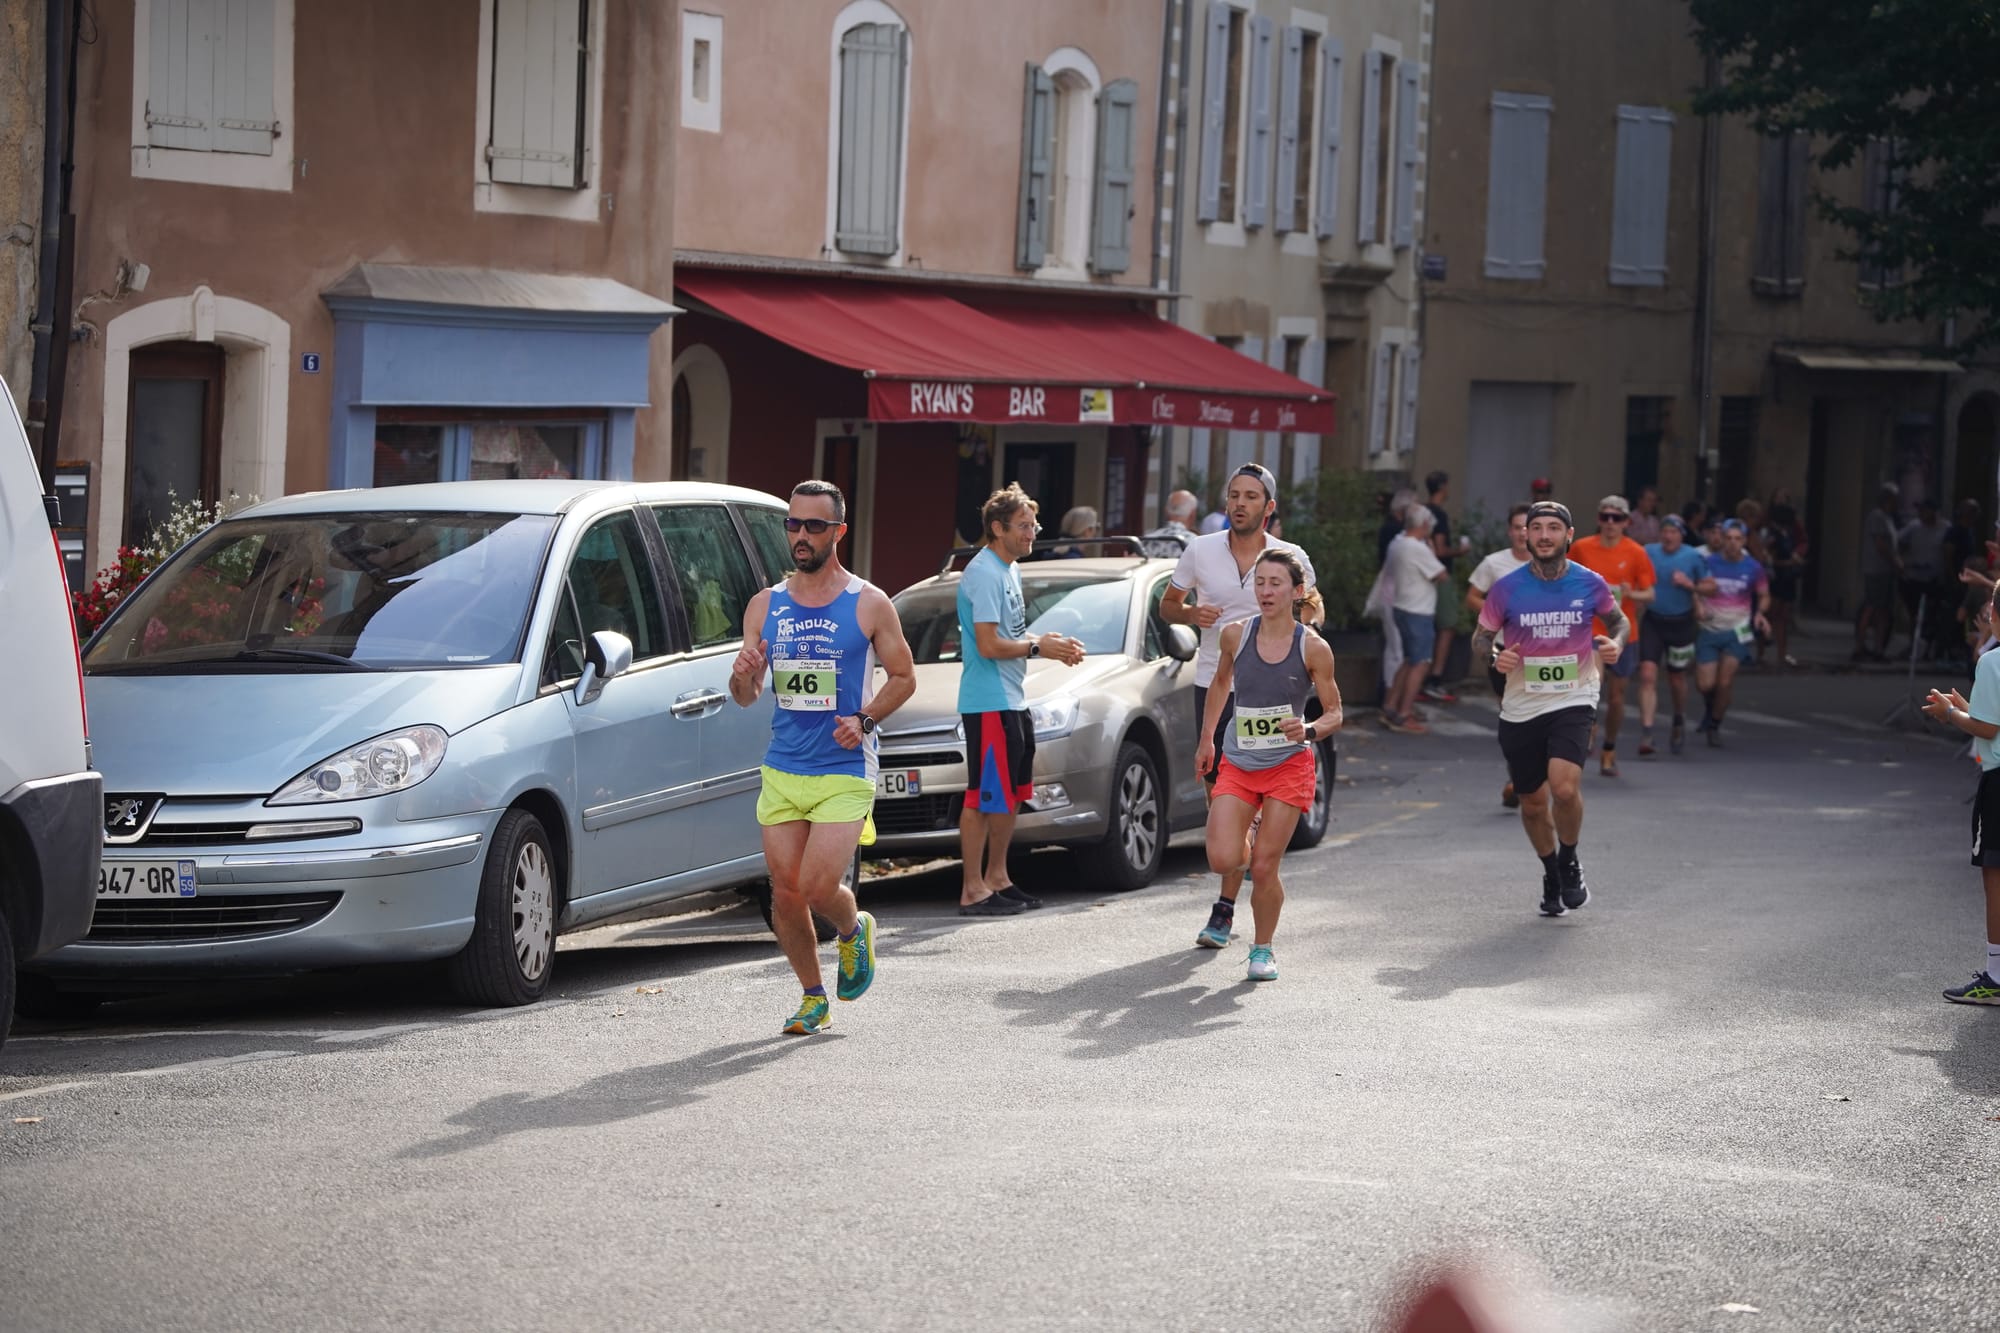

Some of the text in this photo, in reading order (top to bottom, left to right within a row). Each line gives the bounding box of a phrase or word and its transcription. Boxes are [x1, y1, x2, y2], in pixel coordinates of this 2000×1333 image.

[308, 356, 315, 370] 6
[911, 383, 1046, 416] RYAN'S BAR
[1520, 611, 1583, 627] MARVEJOLS
[1533, 625, 1571, 639] MENDE
[1539, 666, 1564, 681] 60
[787, 673, 818, 694] 46
[1243, 717, 1283, 736] 192
[181, 879, 194, 892] 59
